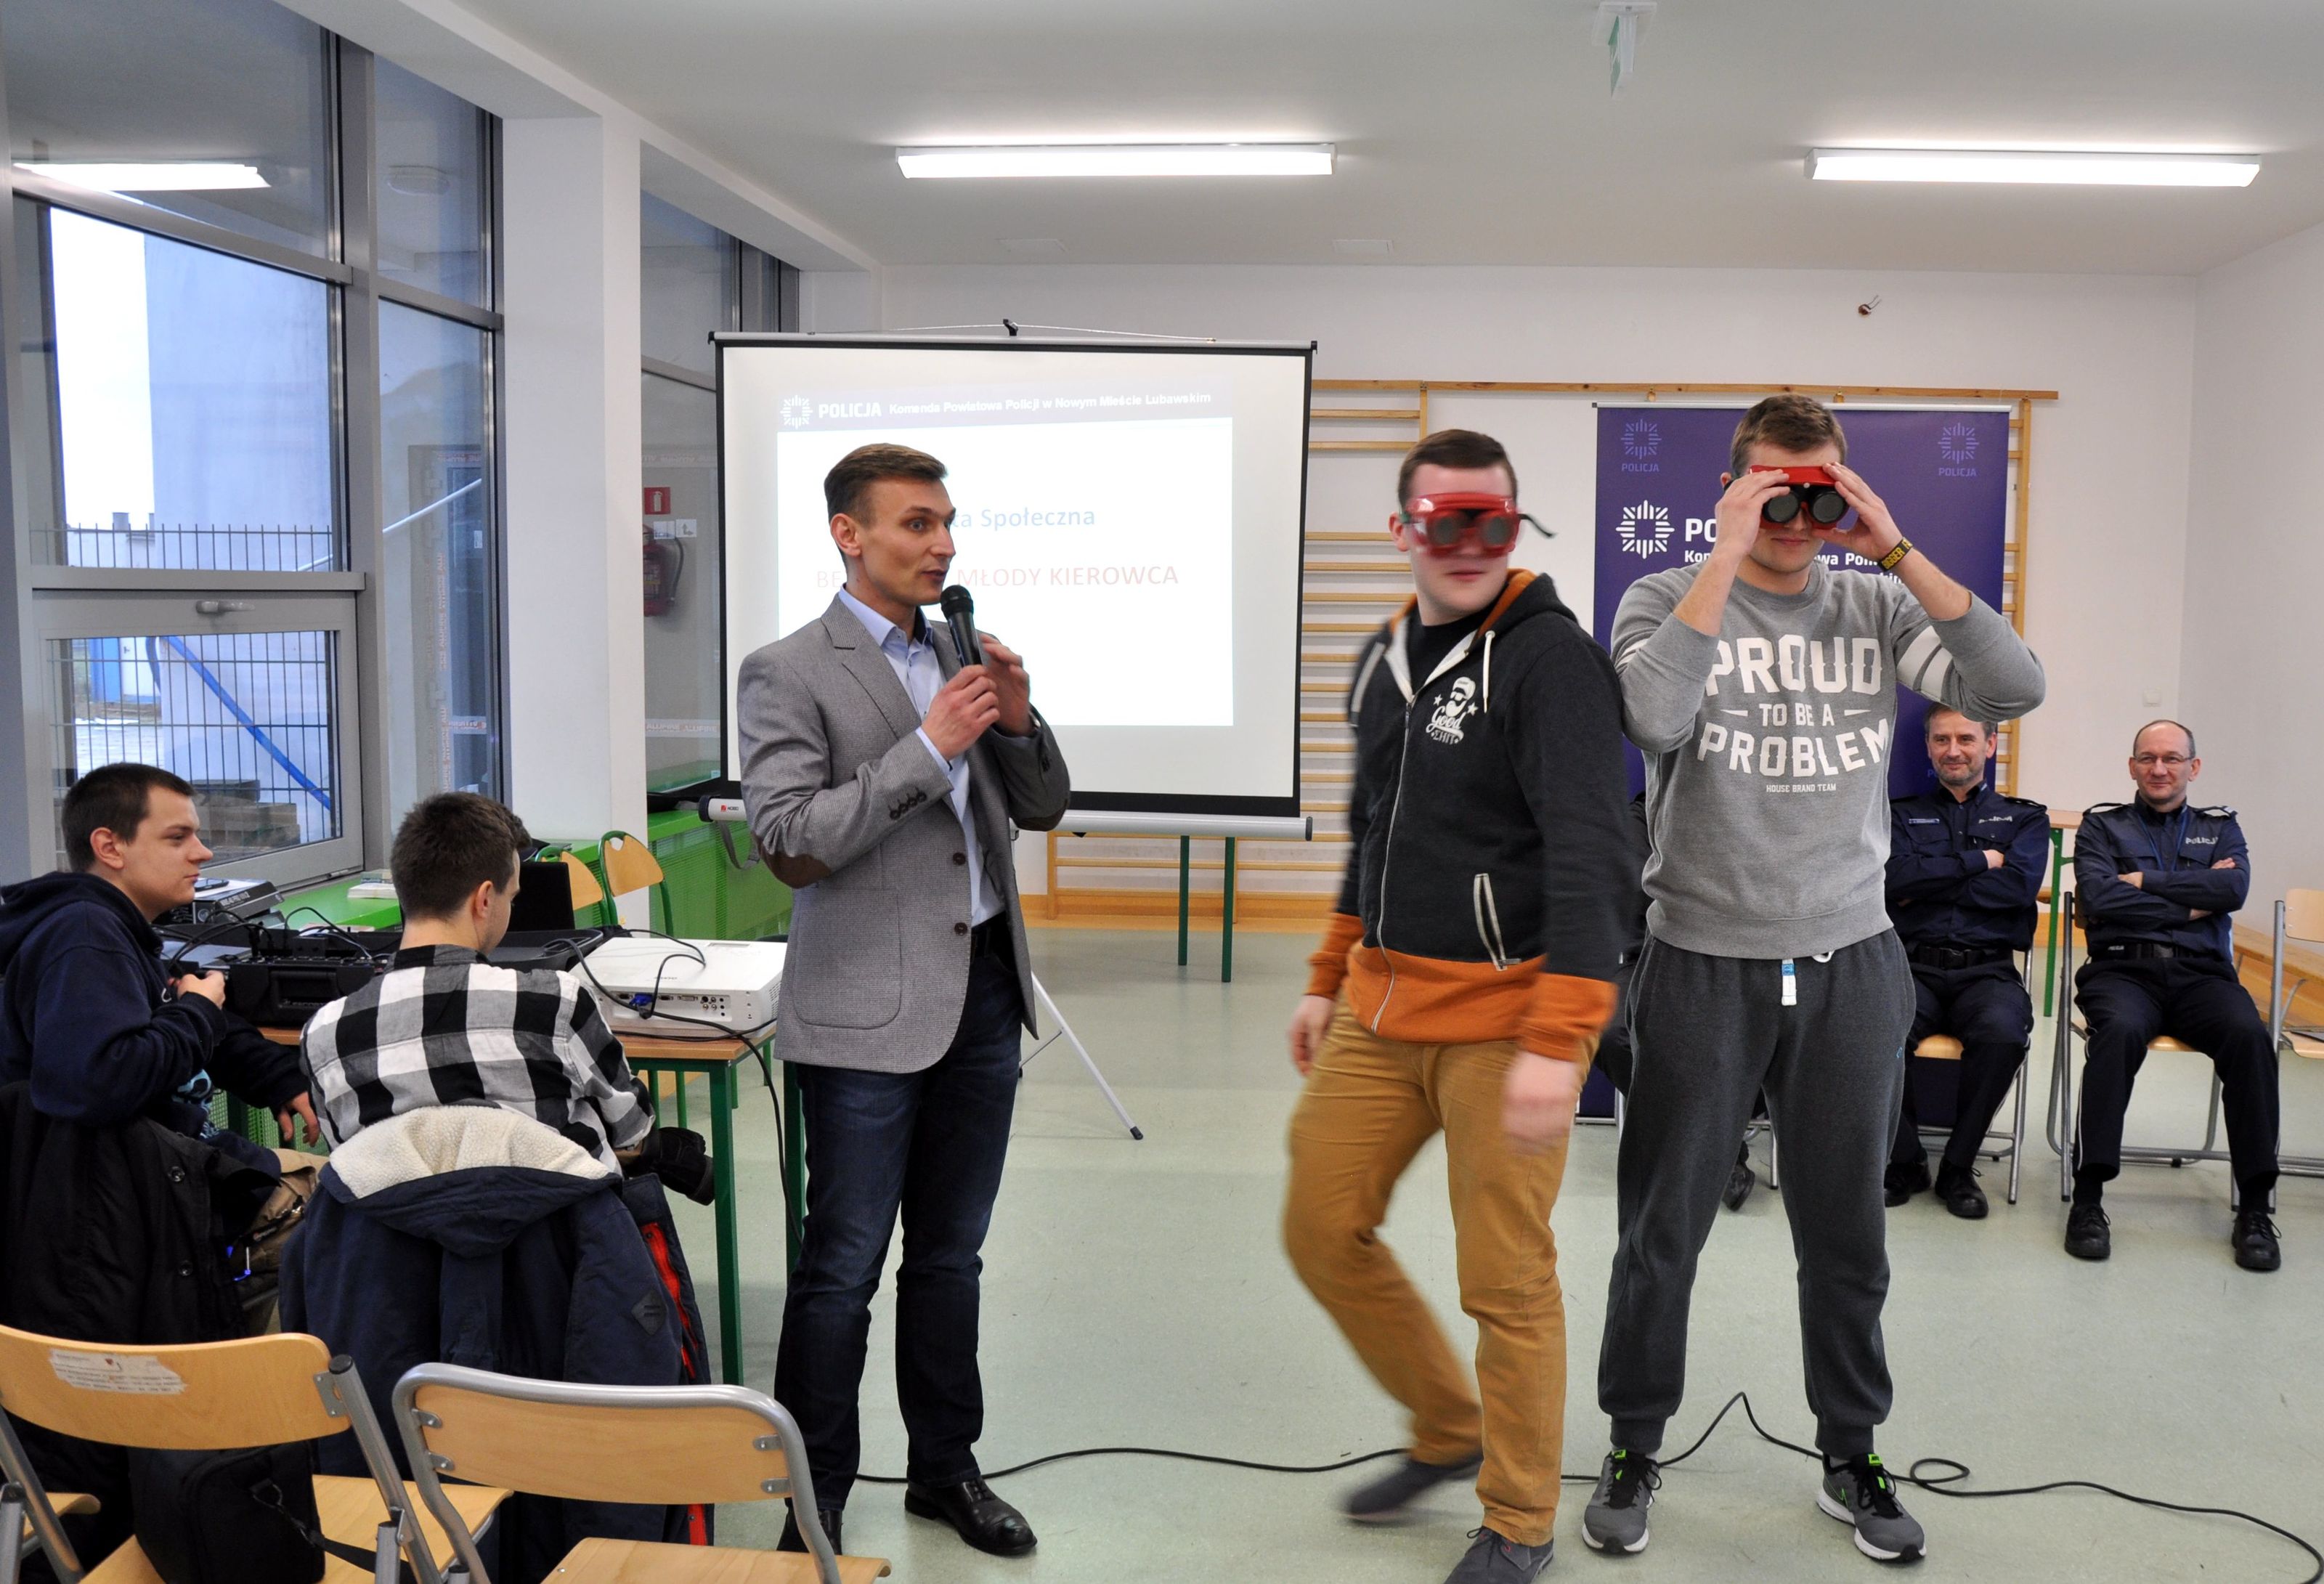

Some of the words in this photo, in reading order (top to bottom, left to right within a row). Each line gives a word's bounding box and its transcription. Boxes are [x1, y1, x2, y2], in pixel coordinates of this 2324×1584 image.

[818, 402, 882, 418] POLICJA
[890, 402, 940, 415] Komenda
[944, 399, 1002, 413] Powiatowa
[1006, 398, 1040, 411] Policji
[1055, 397, 1097, 410] Nowym
[1100, 396, 1141, 407] Mieście
[1145, 393, 1211, 405] Lubawskim
[1622, 463, 1659, 472] POLICJA
[1938, 467, 1976, 476] POLICJA
[981, 508, 1095, 531] Społeczna
[957, 568, 1041, 587] MŁODY
[1050, 566, 1179, 585] KIEROWCA
[1705, 634, 1882, 696] PROUD
[1758, 703, 1787, 726] TO
[1795, 702, 1814, 726] BE
[1822, 704, 1835, 726] A
[1697, 718, 1889, 777] PROBLEM
[1792, 784, 1815, 792] BRAND
